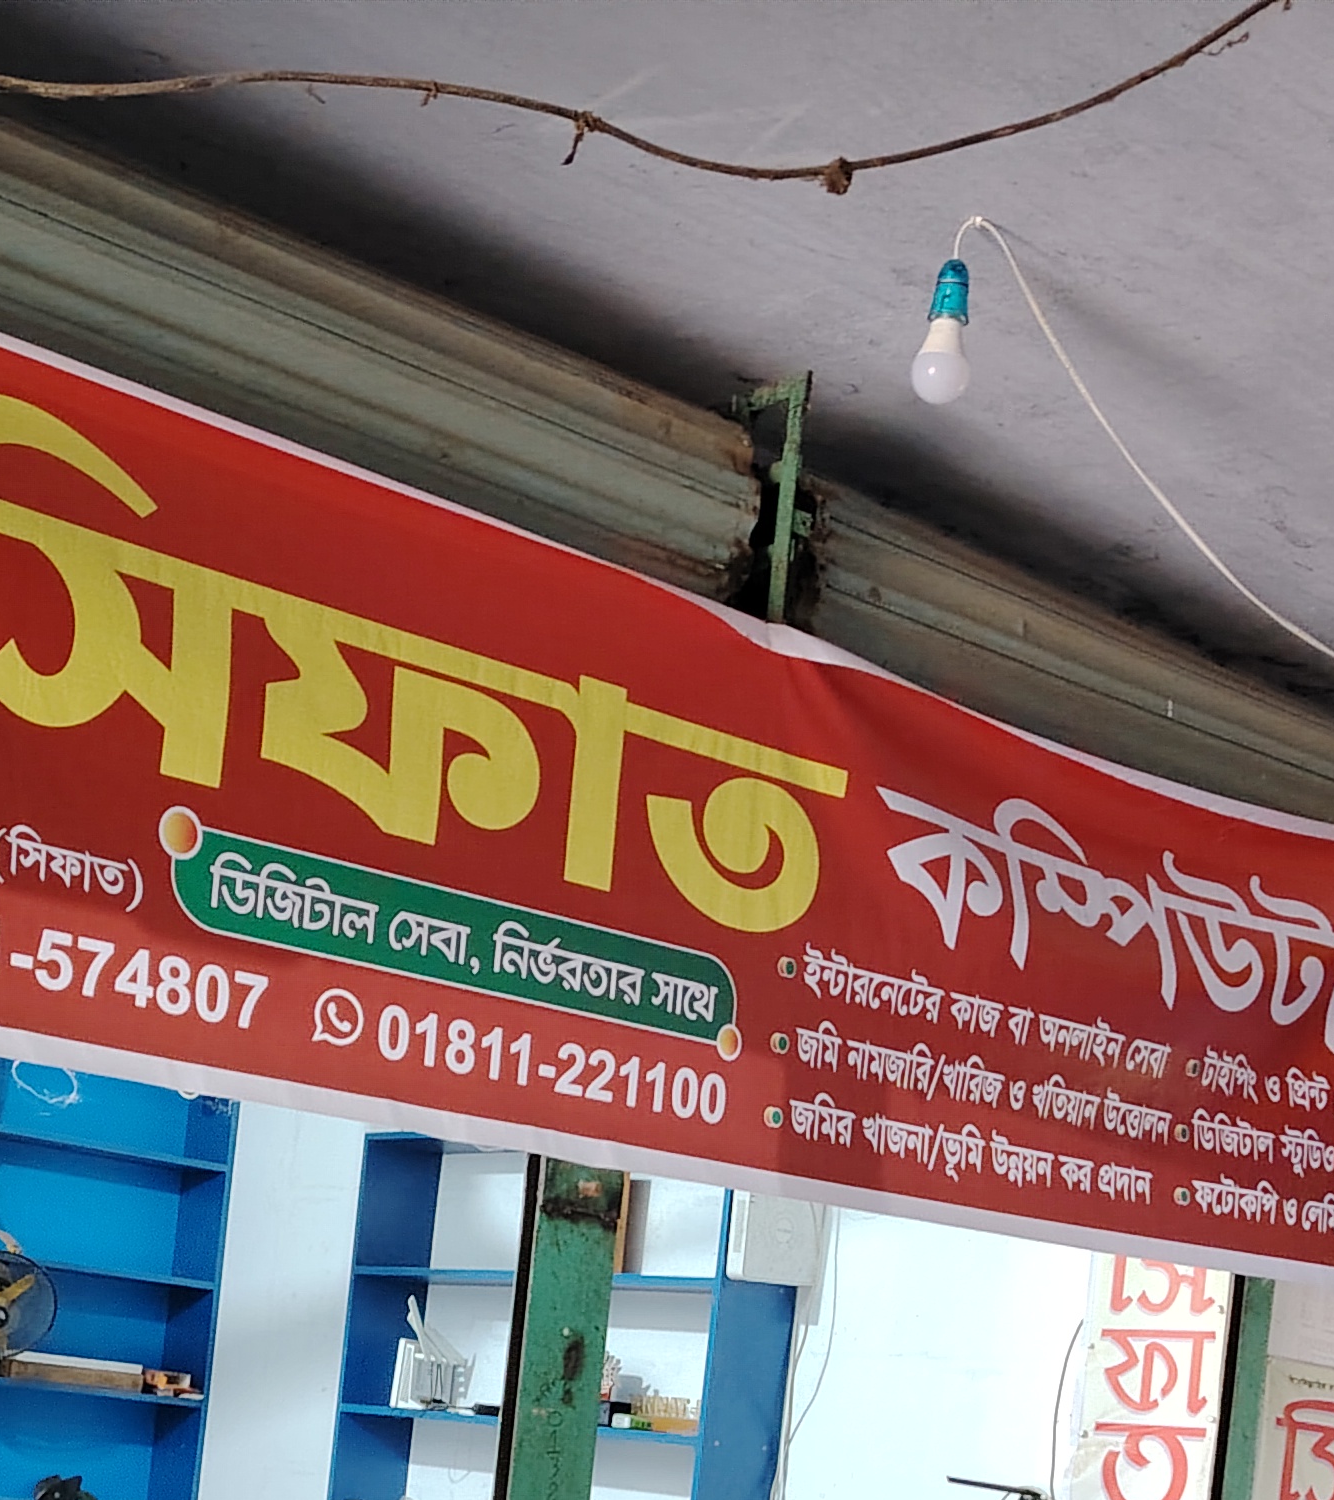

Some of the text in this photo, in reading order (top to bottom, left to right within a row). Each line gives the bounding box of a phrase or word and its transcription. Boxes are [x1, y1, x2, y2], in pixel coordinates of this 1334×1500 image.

[209, 851, 719, 1024] ডিজিটাল সেবা, নির্ভরতার সাথে
[377, 1003, 727, 1125] 01811-221100
[803, 943, 1172, 1080] ইন্টারনেটের কাজ বা অনলাইন সেবা
[796, 1019, 1172, 1147] জমি নামজারি/খারিজ ও খতিয়ান উত্তোলন
[1192, 1107, 1274, 1164] ডিজিটাল
[1202, 1045, 1260, 1105] টাইপিং
[1264, 1072, 1281, 1097] ও
[1286, 1067, 1329, 1114] প্রিন্ট
[790, 1090, 1152, 1205] জমির খাজনা/ভূমি উন্নয়ন কর প্রদান
[1192, 1171, 1277, 1230] ফটোকপি
[1282, 1199, 1298, 1226] ও
